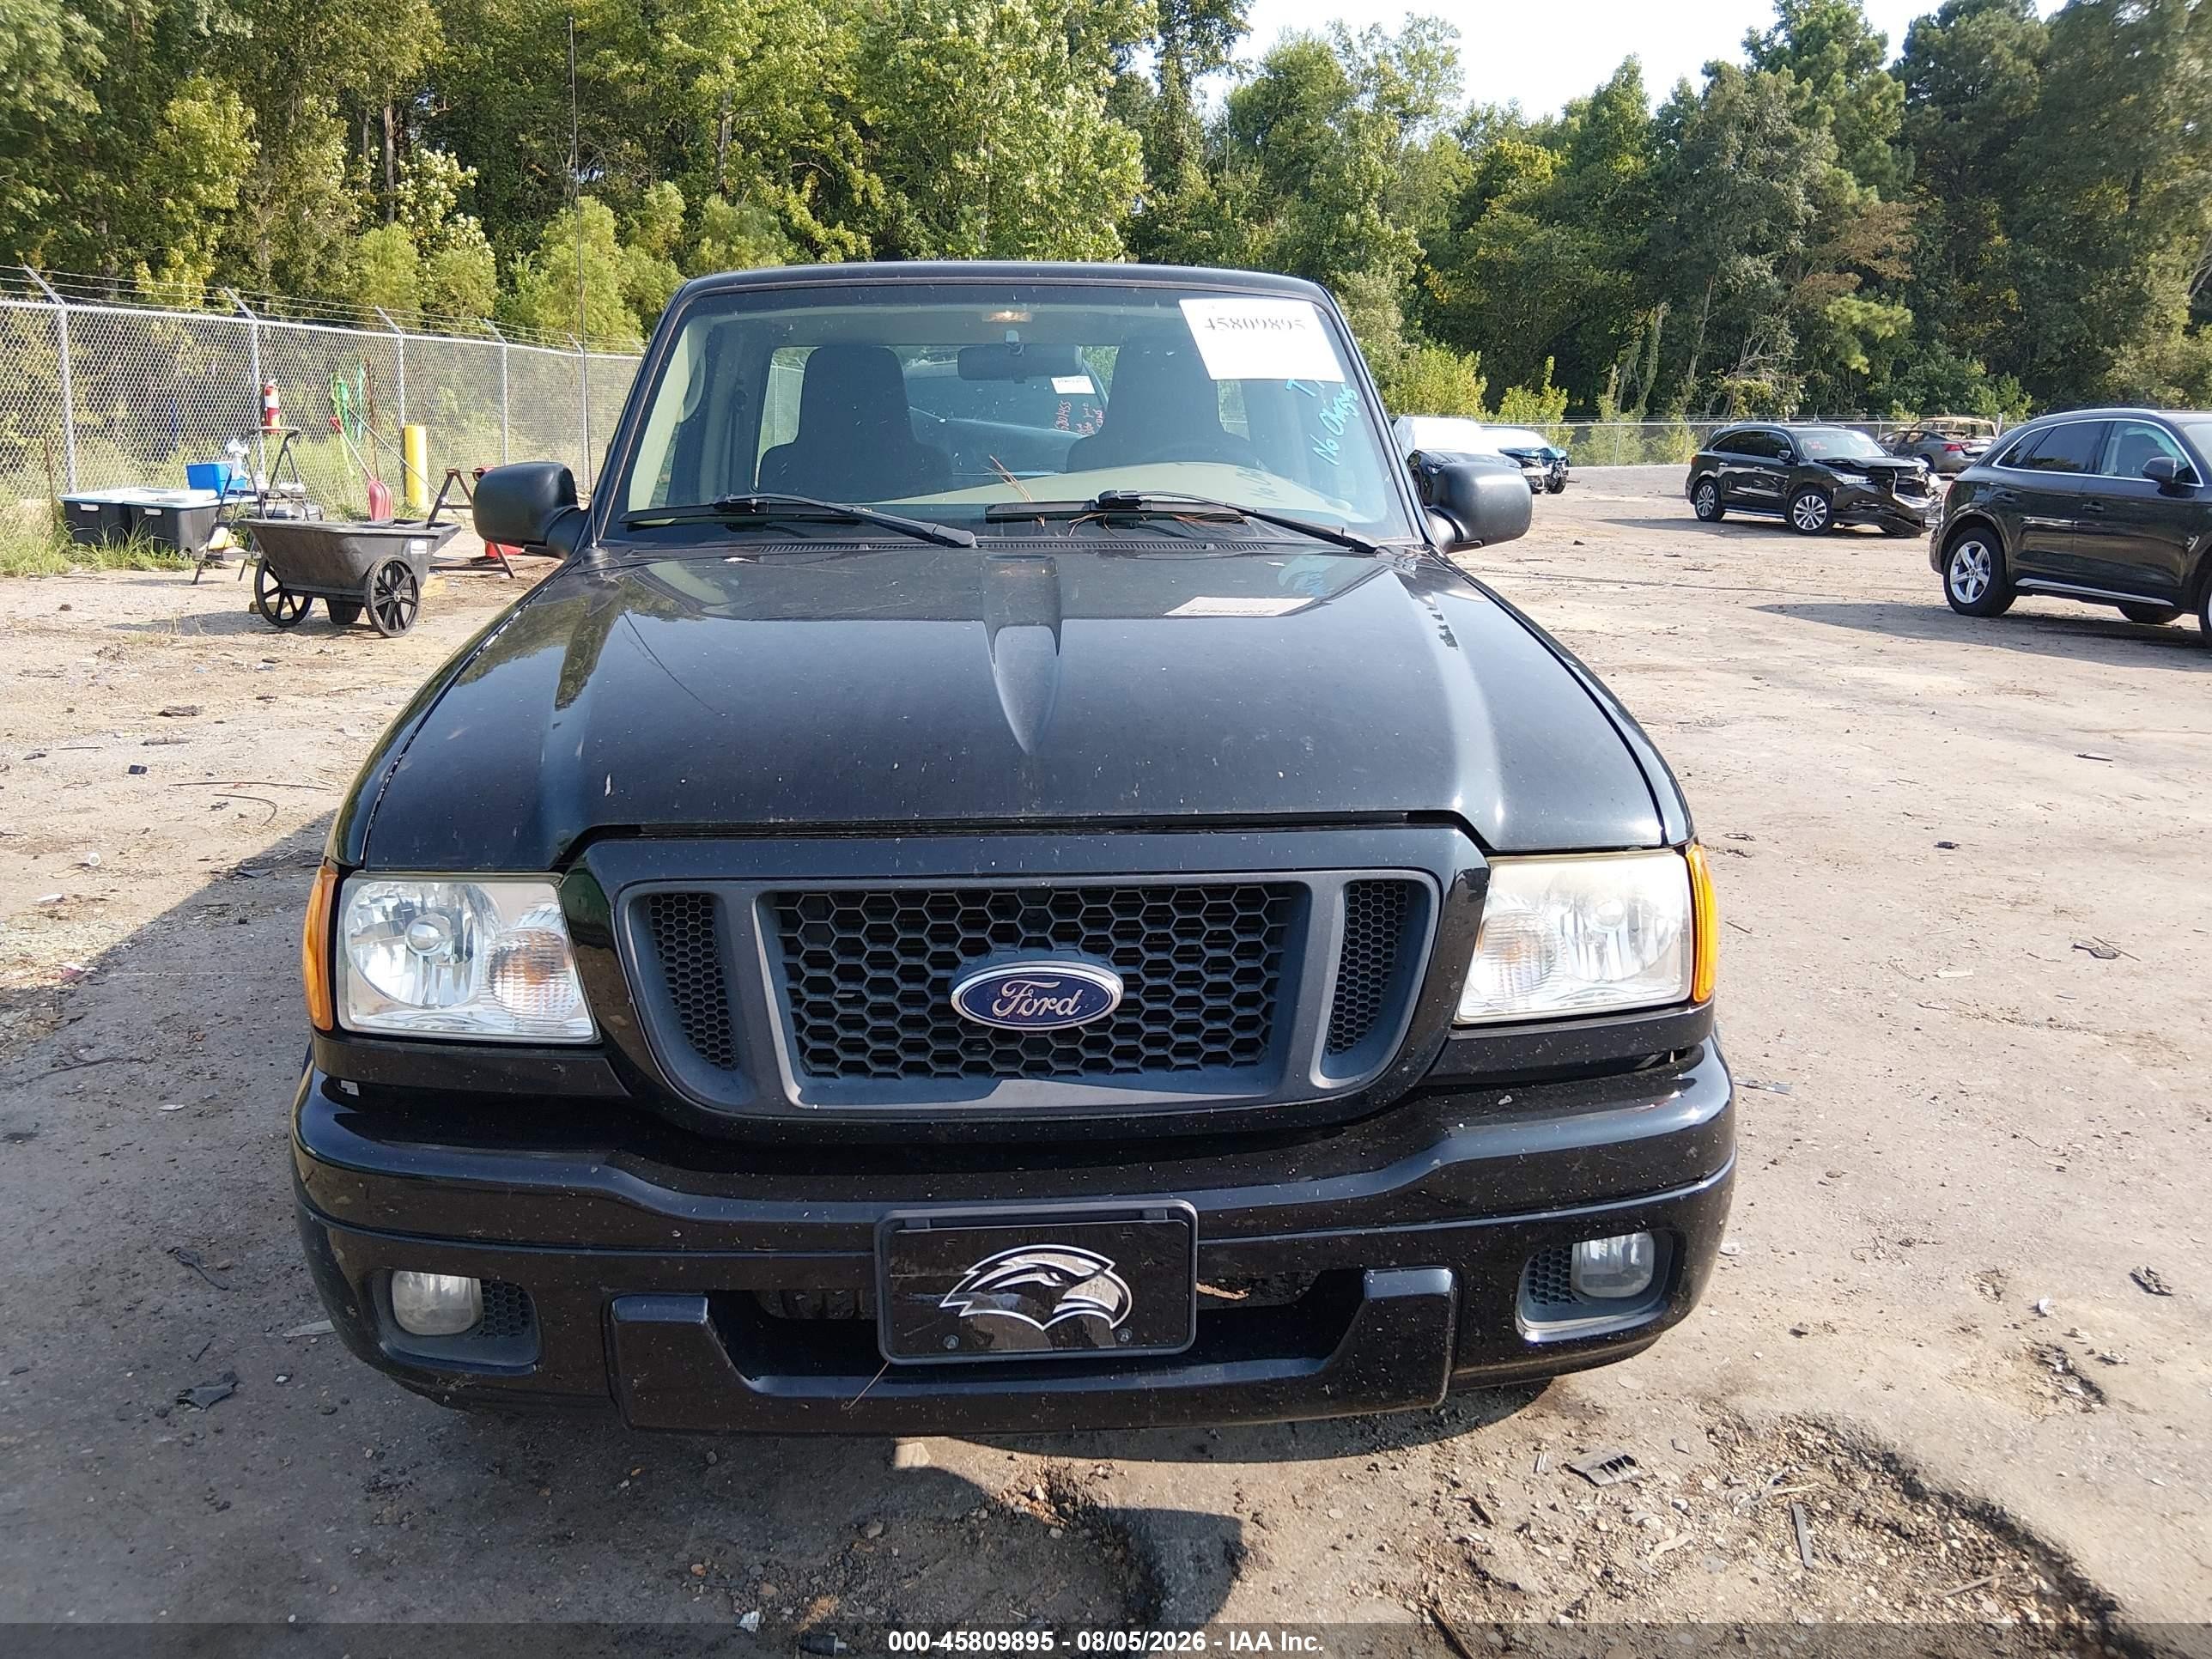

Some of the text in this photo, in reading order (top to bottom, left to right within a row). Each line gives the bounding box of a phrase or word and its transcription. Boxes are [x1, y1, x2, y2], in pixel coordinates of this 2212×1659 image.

[1204, 316, 1306, 331] 45809895
[1309, 434, 1340, 466] No
[992, 979, 1084, 1018] Ford
